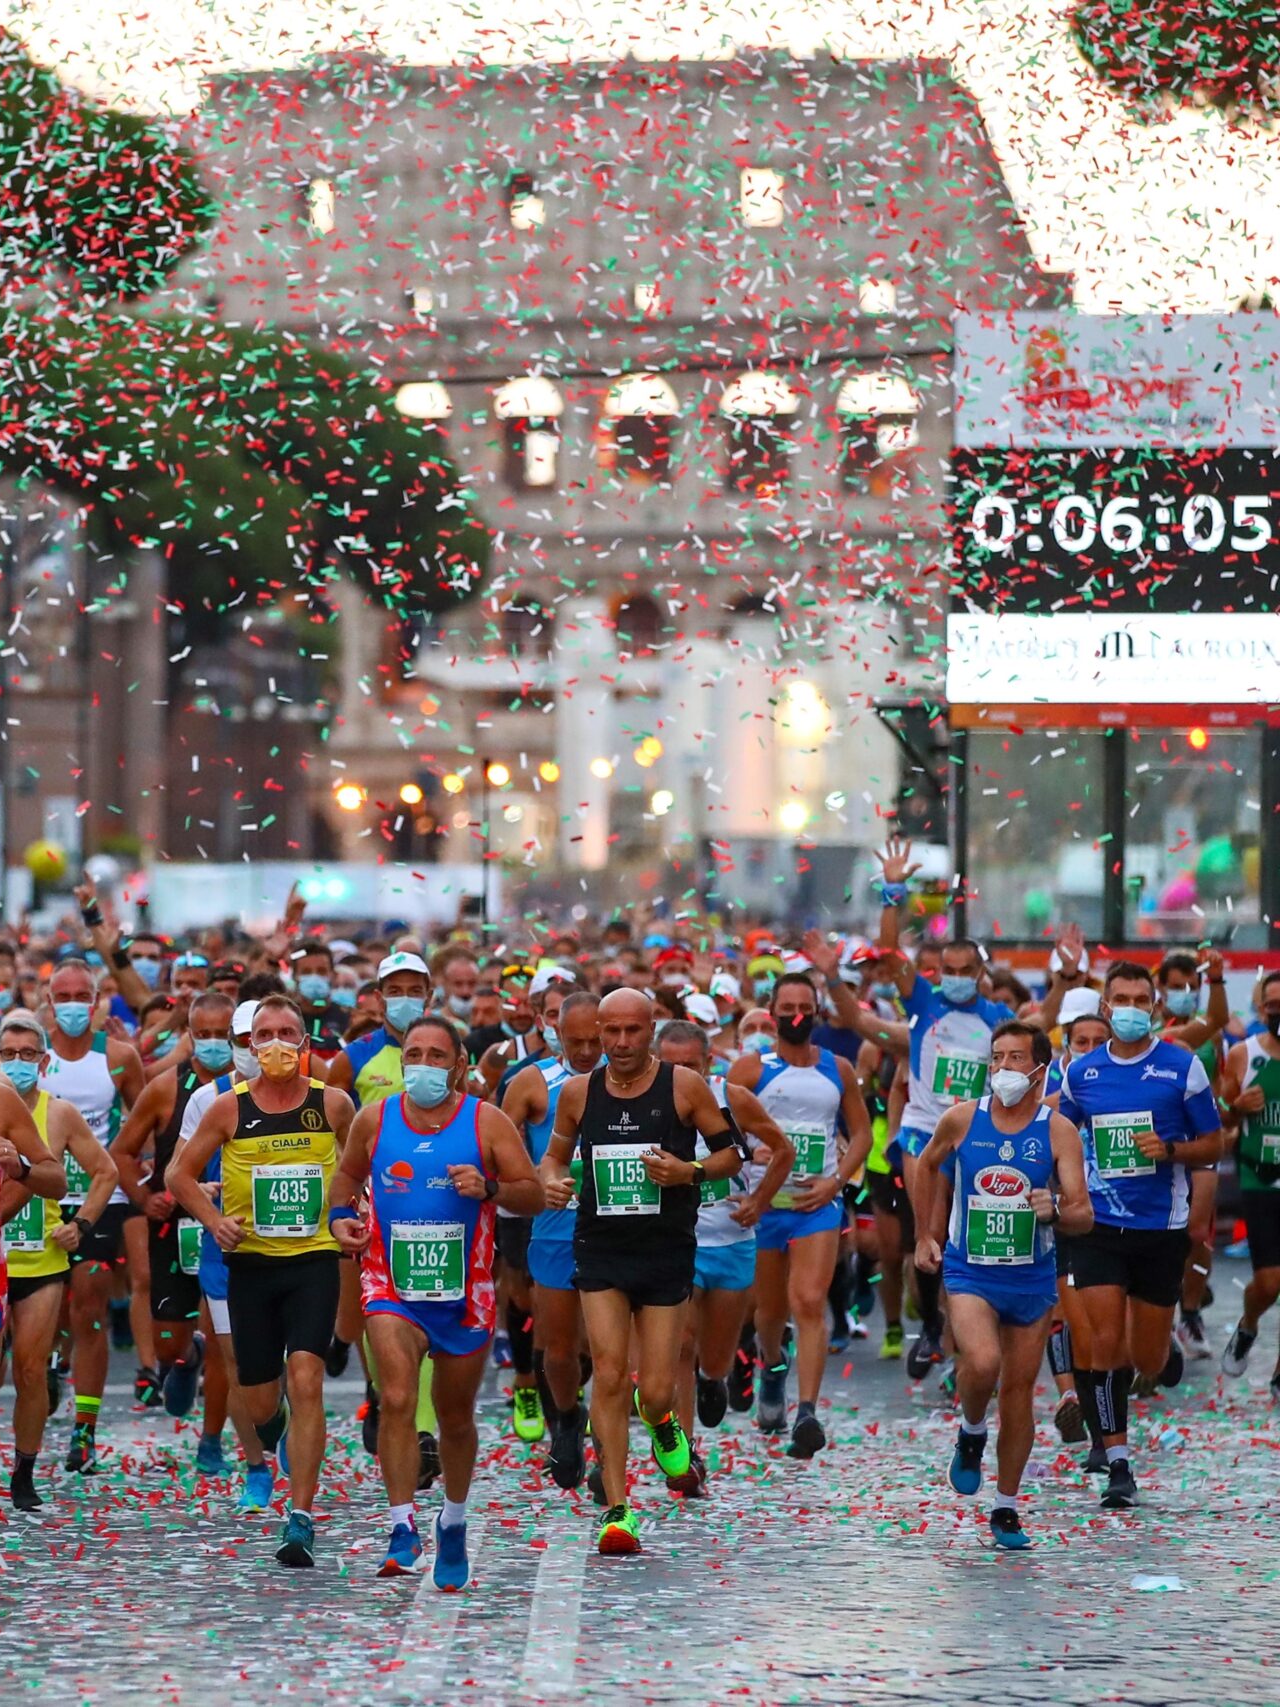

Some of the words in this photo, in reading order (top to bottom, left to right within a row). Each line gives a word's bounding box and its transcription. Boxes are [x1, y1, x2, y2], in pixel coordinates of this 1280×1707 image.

[970, 495, 1273, 553] 0:06:05
[947, 1060, 979, 1081] 5147
[271, 1138, 311, 1147] CIALAB
[1108, 1129, 1134, 1149] 780
[1106, 1159, 1112, 1168] 2
[1129, 1158, 1137, 1167] B
[608, 1162, 646, 1184] 1155
[984, 1171, 1023, 1195] Sigel
[269, 1181, 309, 1203] 4835
[608, 1194, 614, 1204] 2
[632, 1194, 641, 1204] B
[270, 1214, 276, 1224] 7
[296, 1214, 305, 1225] B
[986, 1213, 1014, 1235] 581
[19, 1231, 27, 1240] B
[410, 1231, 438, 1239] acea
[407, 1243, 449, 1267] 1362
[981, 1244, 986, 1255] 1
[1006, 1246, 1015, 1256] B
[406, 1278, 414, 1290] 2
[434, 1279, 444, 1290] B
